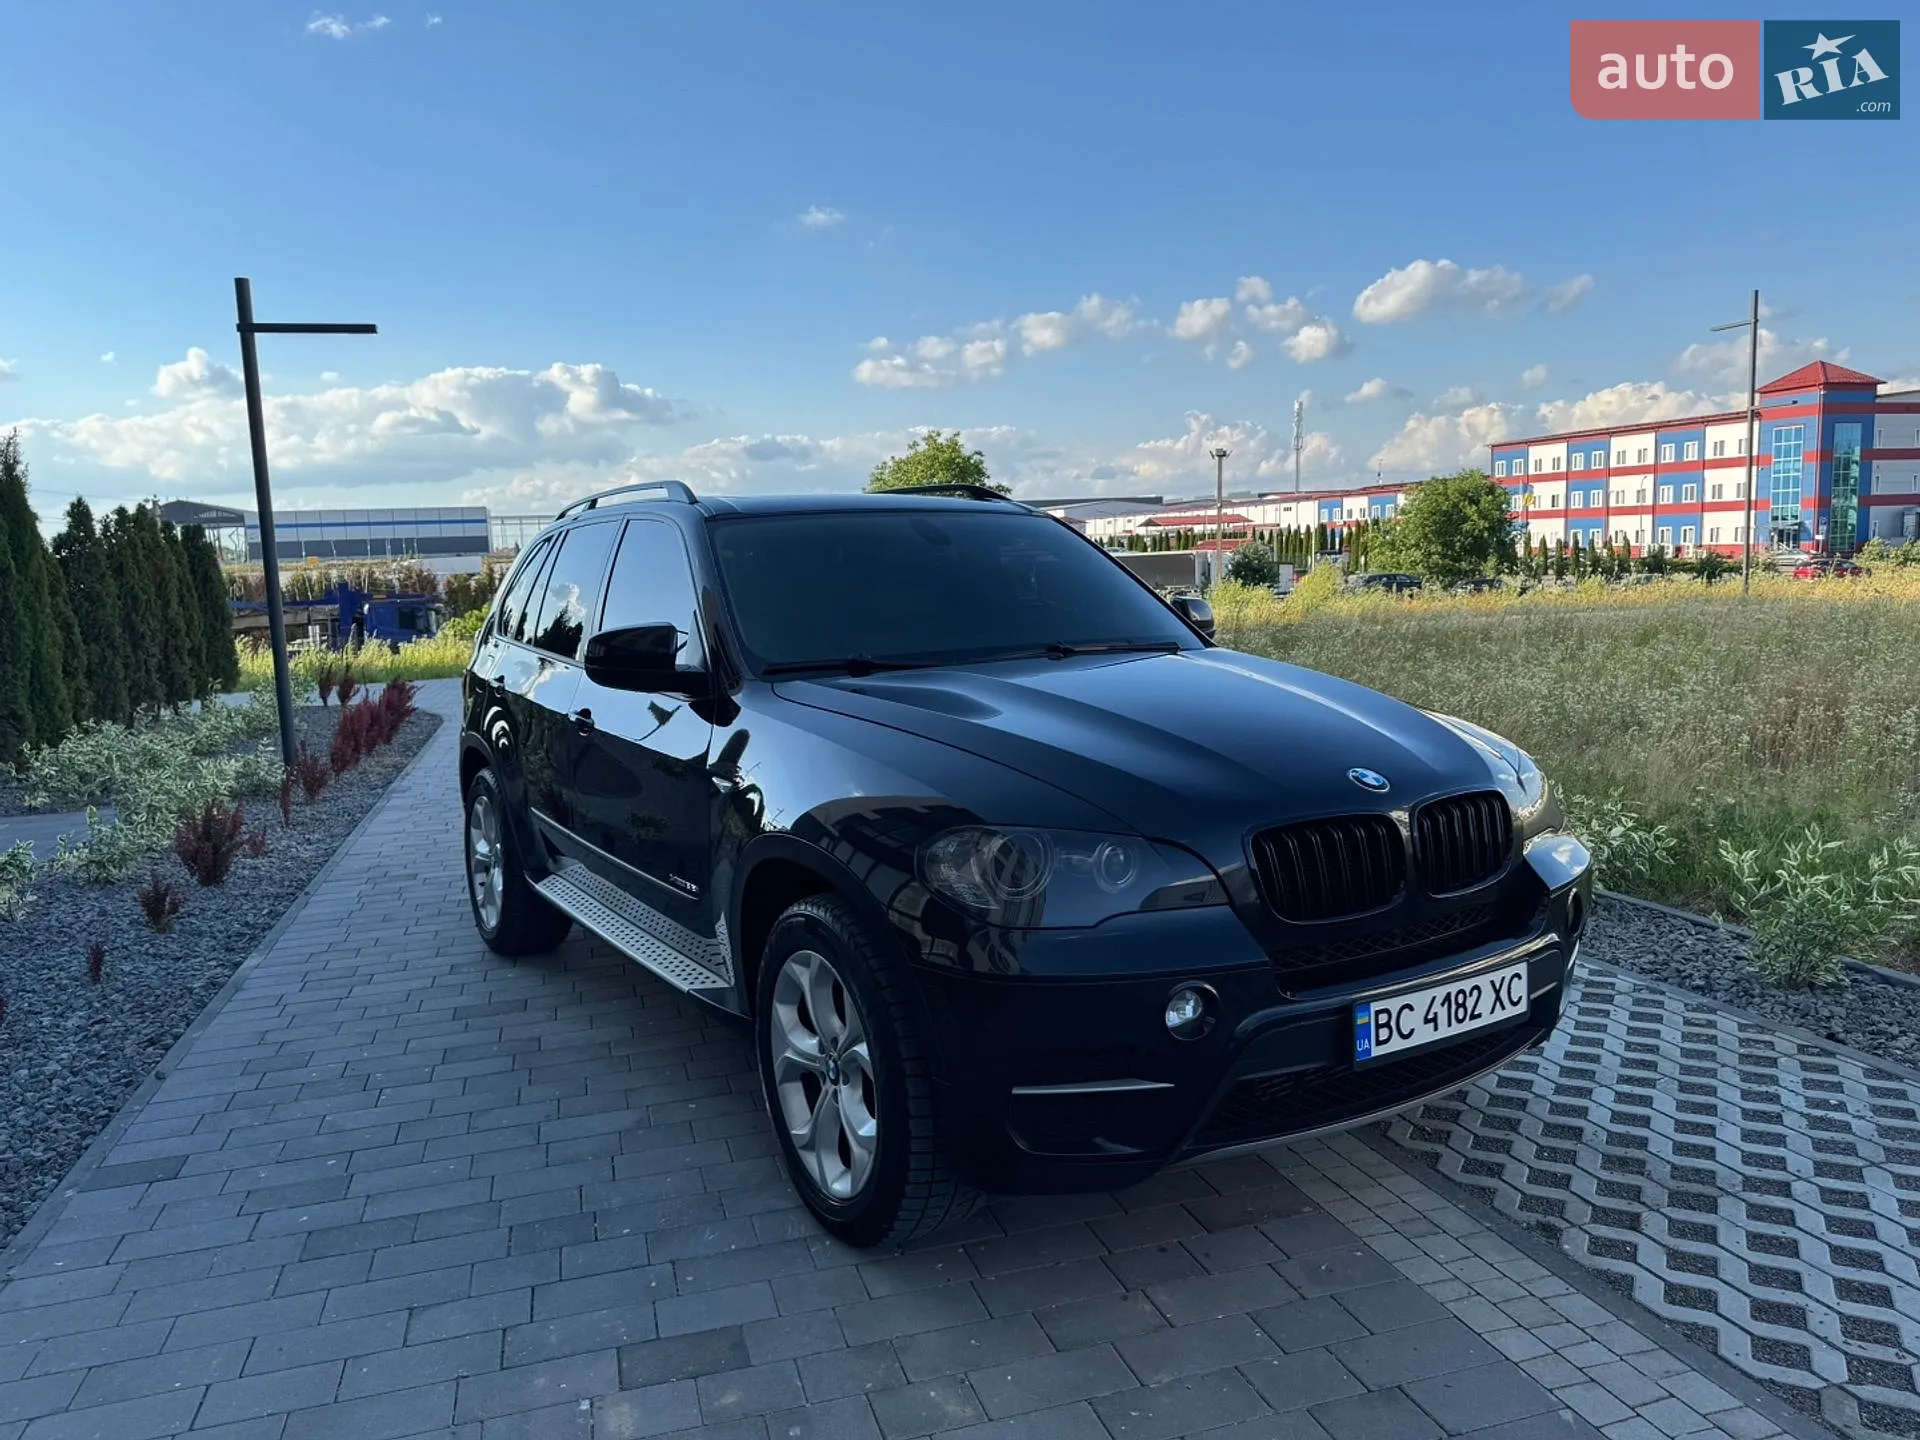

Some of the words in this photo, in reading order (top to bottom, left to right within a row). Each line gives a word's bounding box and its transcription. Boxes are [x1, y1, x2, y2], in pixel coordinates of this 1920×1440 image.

[1374, 1003, 1415, 1047] BC
[1423, 984, 1482, 1032] 4182
[1489, 972, 1523, 1015] XC
[1356, 1038, 1370, 1051] UA
